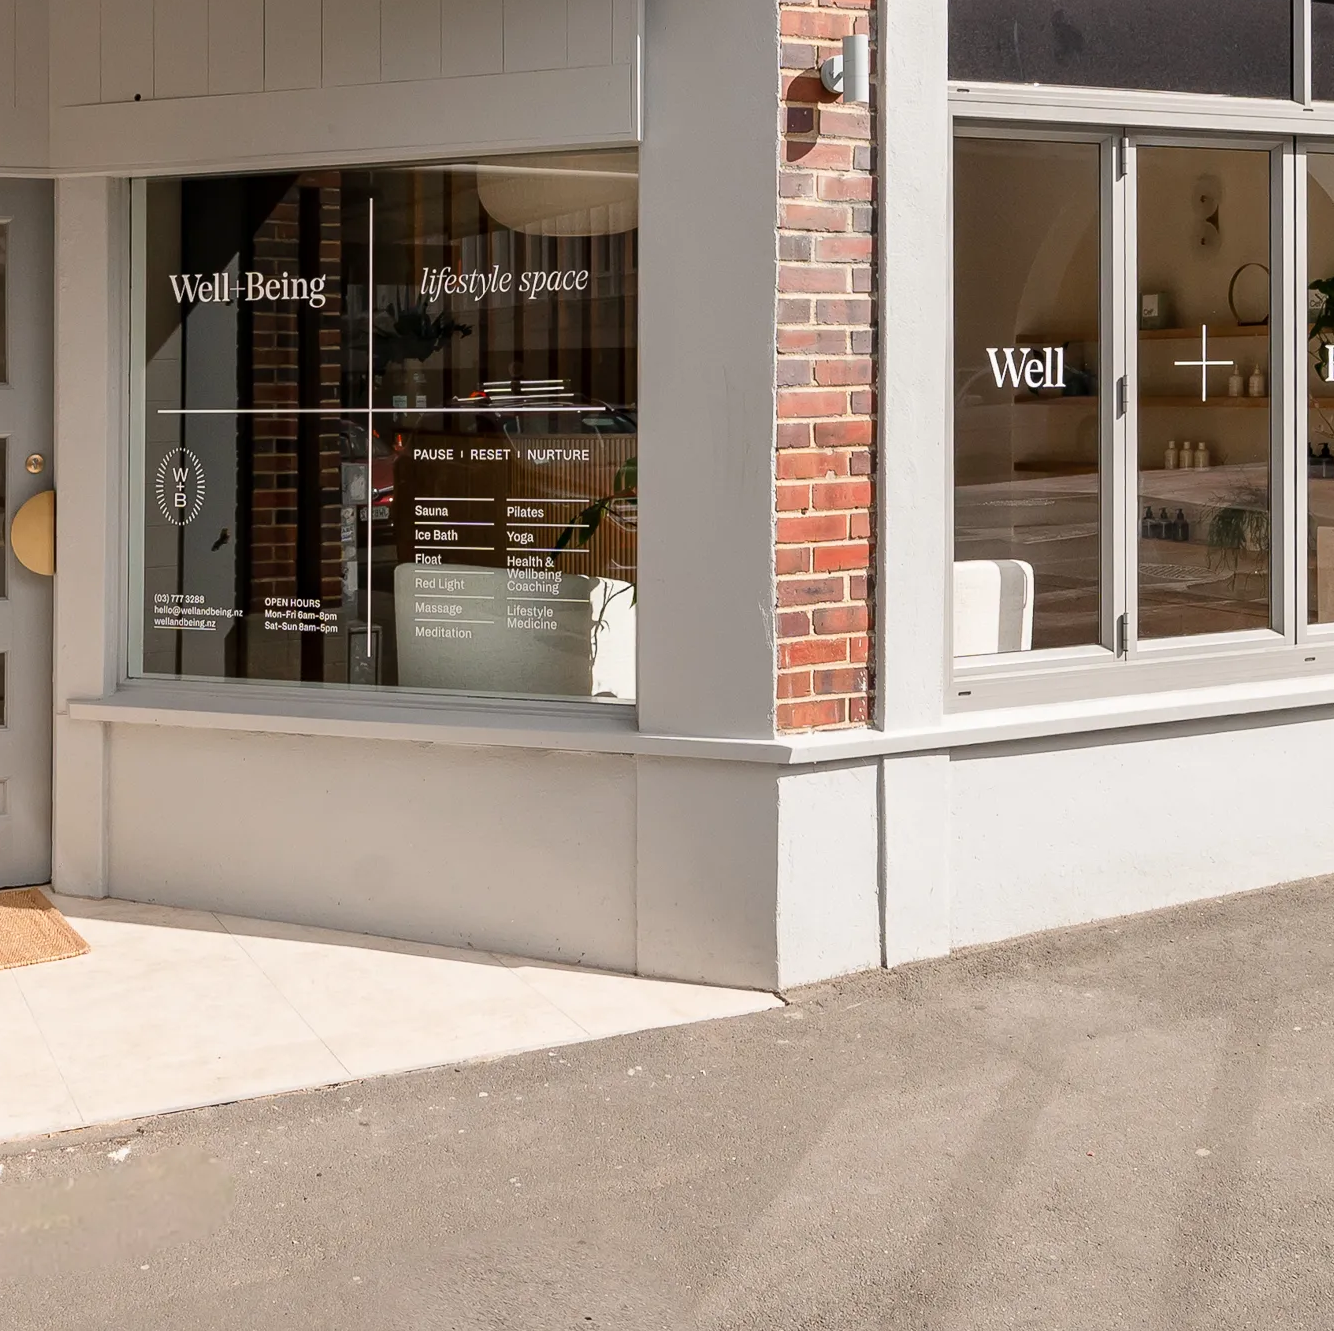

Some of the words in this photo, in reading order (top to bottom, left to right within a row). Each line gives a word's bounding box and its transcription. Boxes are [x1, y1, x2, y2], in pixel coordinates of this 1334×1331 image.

[169, 271, 326, 308] Well+Being
[420, 265, 512, 303] lifestyle
[518, 268, 589, 300] space
[985, 347, 1066, 388] Well
[414, 449, 454, 461] PAUSE
[470, 449, 511, 461] RESET
[527, 449, 590, 461] NURTURE
[414, 505, 449, 517] Sauna
[507, 506, 544, 518] Pilates
[415, 529, 431, 541] Ice
[433, 529, 458, 541] Bath
[506, 531, 534, 545] Yoga
[415, 554, 442, 566] Float
[507, 556, 543, 567] Health
[545, 557, 554, 568] &
[507, 568, 562, 582] Wellbeing
[415, 578, 436, 589] Red
[438, 578, 465, 592] Light
[507, 581, 560, 595] Coaching
[154, 594, 170, 604] (03)
[170, 594, 184, 603] 777
[185, 594, 205, 604] 3288
[264, 597, 289, 607] OPEN
[290, 598, 321, 608] HOURS
[154, 605, 244, 618] hello@wellandbeing.nz
[415, 602, 463, 616] Massage
[507, 605, 554, 618] Lifestyle
[154, 617, 217, 628] wellandbeing.nz
[507, 618, 557, 630] Medicine
[415, 627, 472, 639] Meditation
